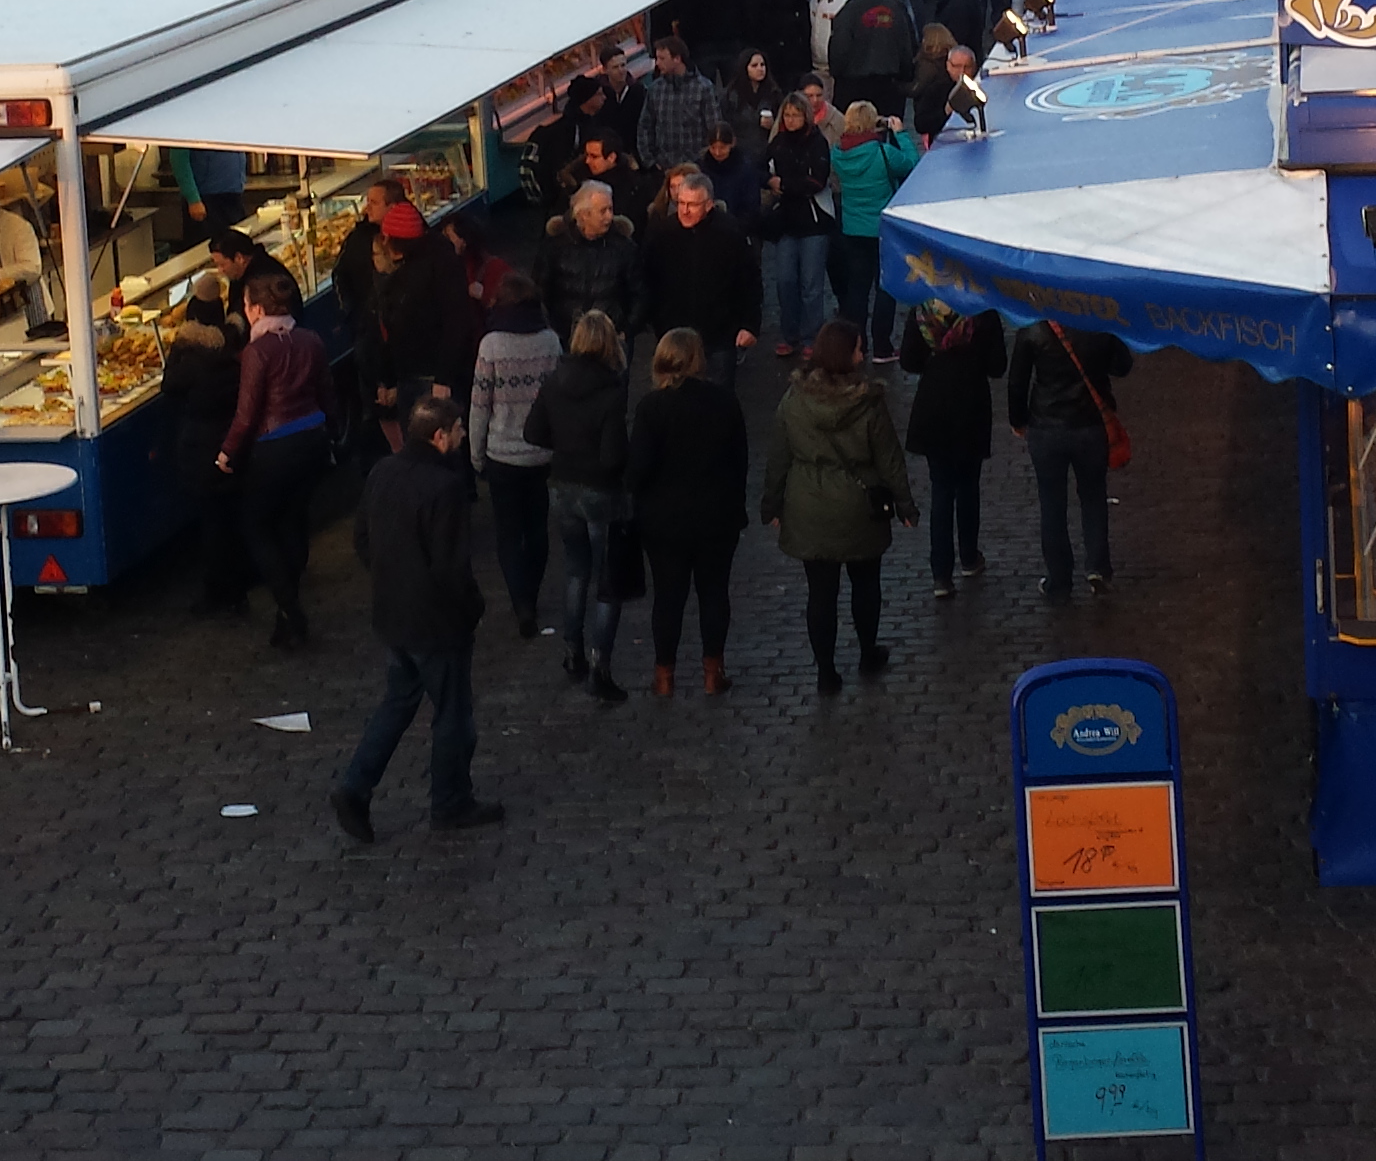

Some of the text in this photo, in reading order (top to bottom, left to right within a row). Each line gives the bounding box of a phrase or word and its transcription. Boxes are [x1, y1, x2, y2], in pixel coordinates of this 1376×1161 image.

[1144, 302, 1297, 356] BACKFISCH
[1073, 726, 1120, 738] Andrea Will
